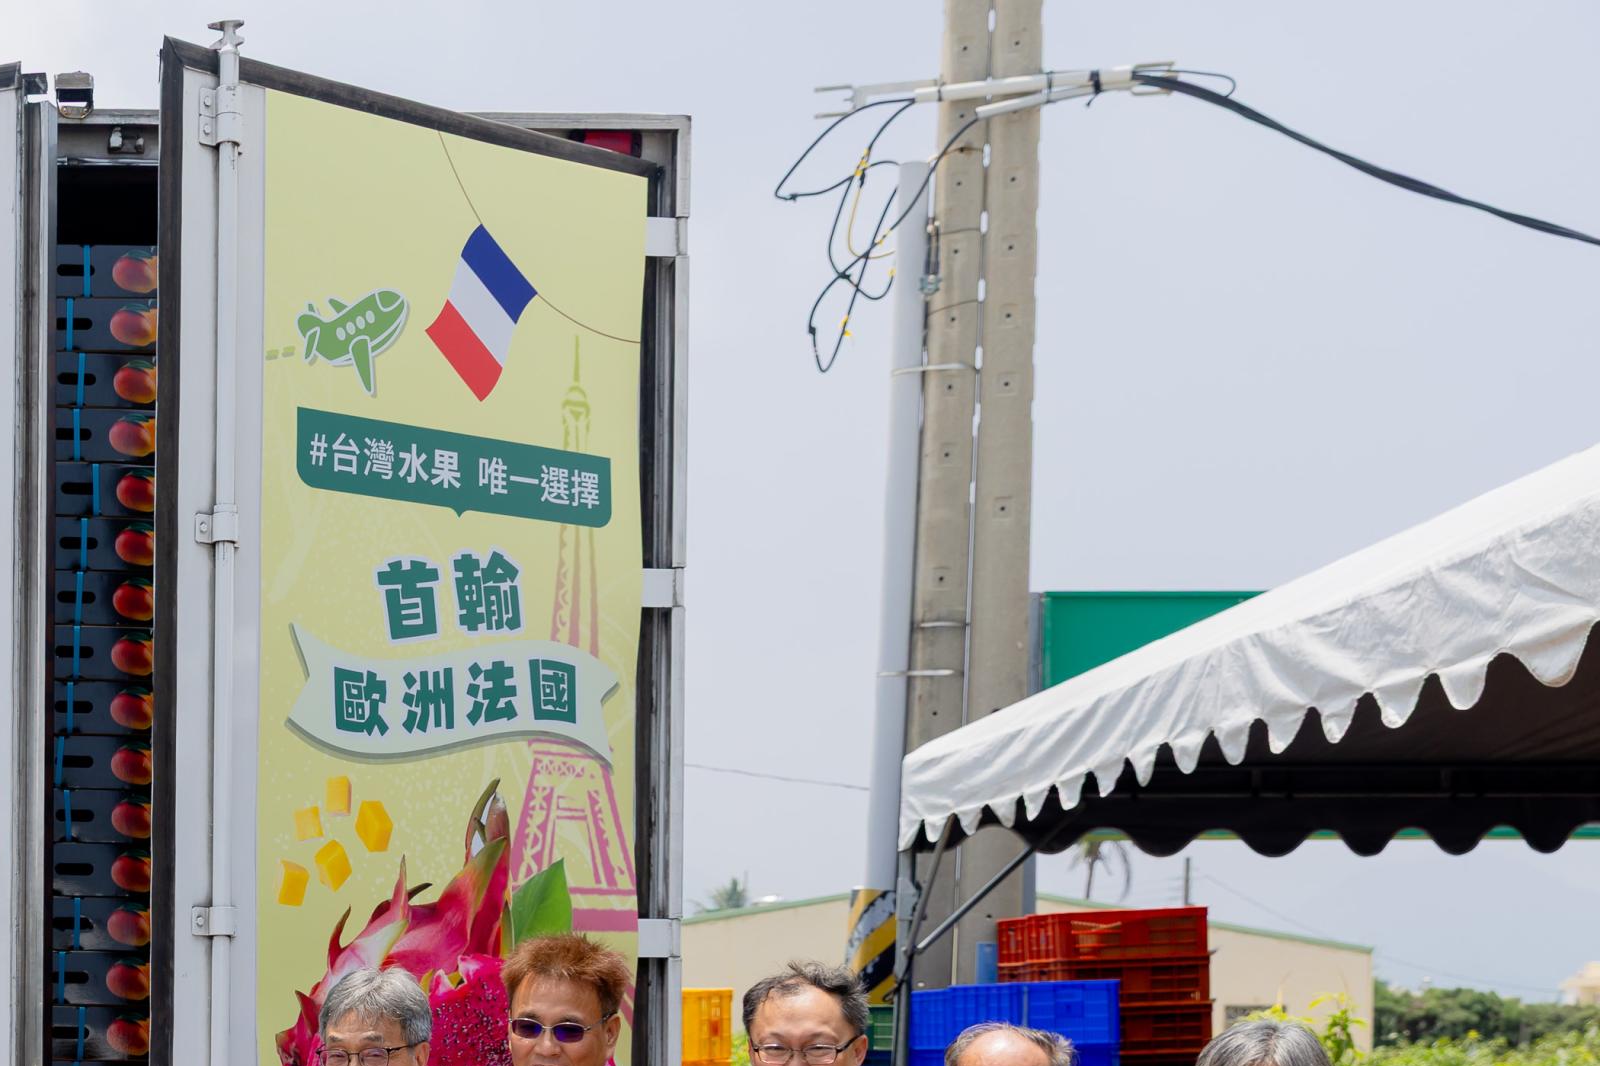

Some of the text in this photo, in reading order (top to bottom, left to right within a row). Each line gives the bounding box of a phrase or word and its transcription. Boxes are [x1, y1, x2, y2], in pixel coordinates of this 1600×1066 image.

[309, 432, 601, 509] #台灣水果 唯一選擇
[375, 550, 523, 641] 首輸
[333, 658, 577, 737] 歐洲法國
